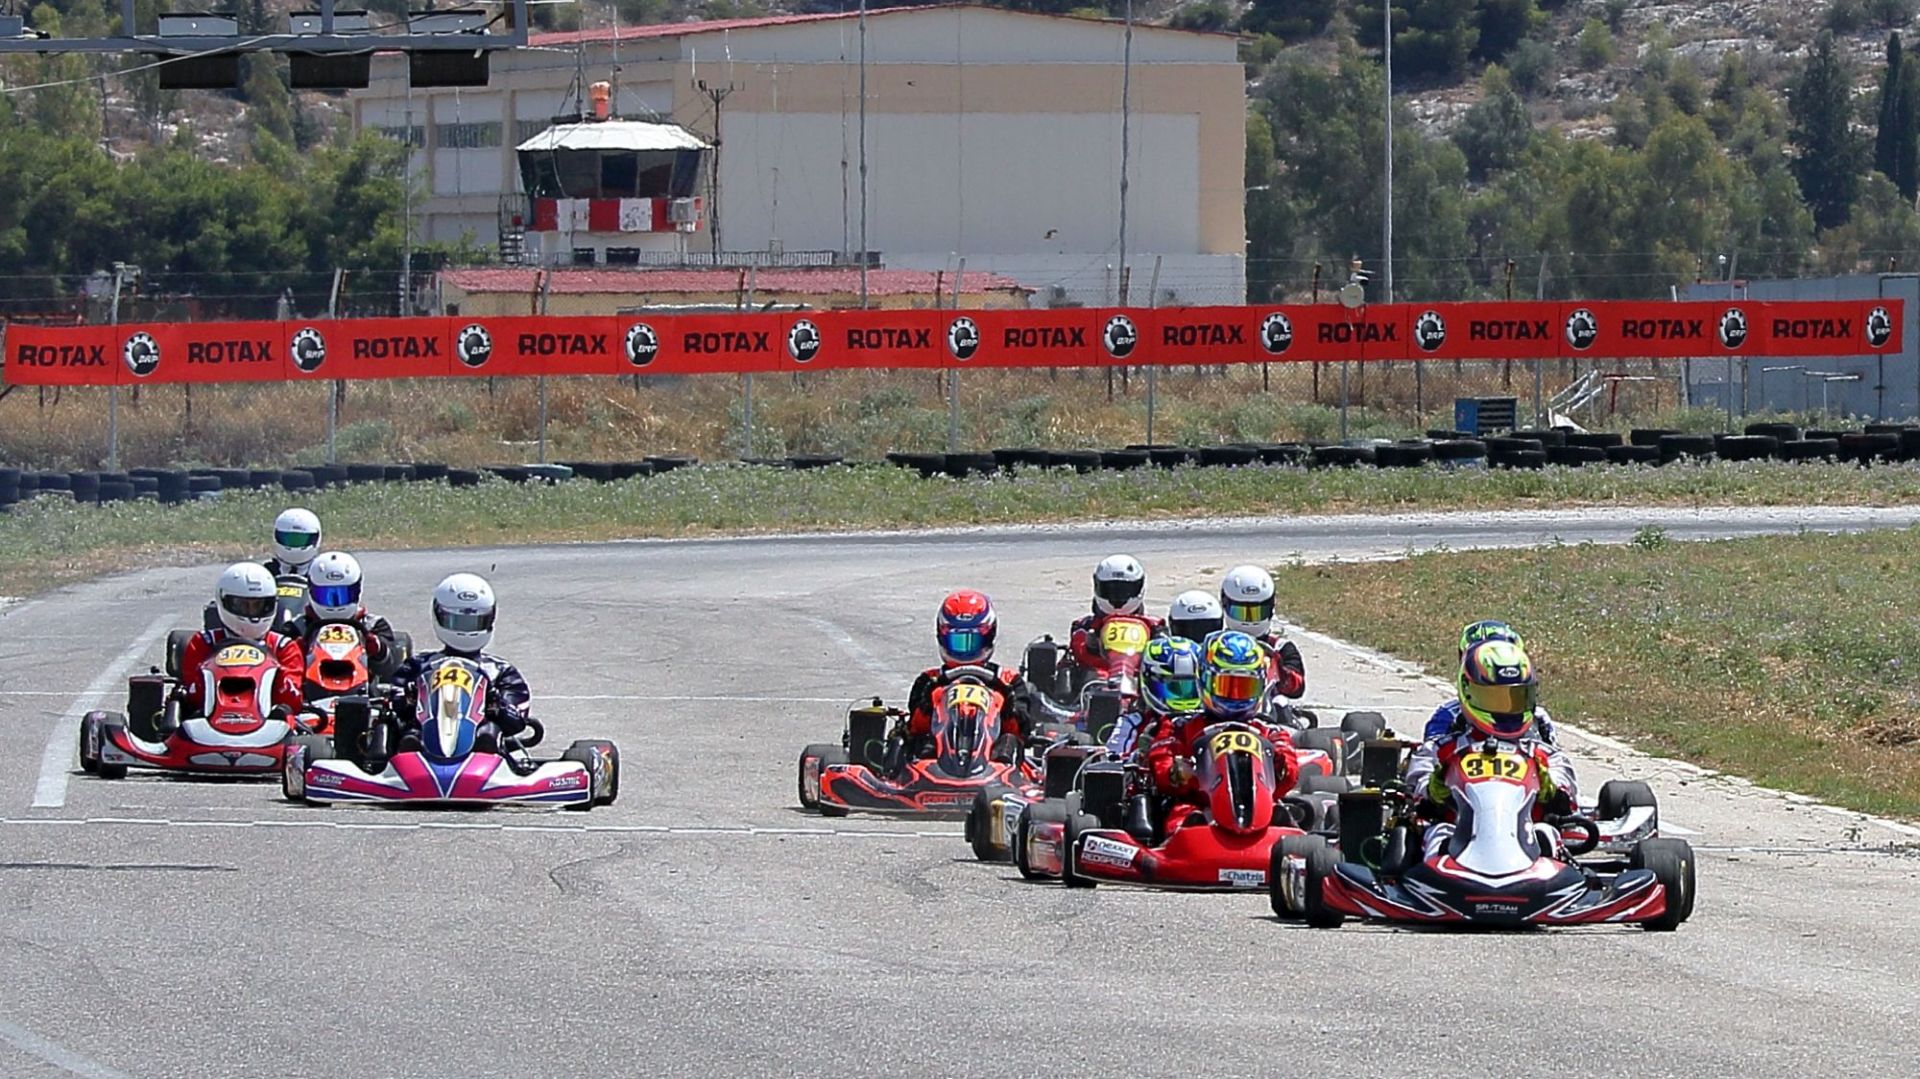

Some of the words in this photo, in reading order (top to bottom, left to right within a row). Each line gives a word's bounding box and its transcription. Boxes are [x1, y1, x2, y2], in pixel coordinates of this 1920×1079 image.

[848, 329, 929, 349] ROTAX
[1005, 328, 1084, 347] ROTAX
[1163, 324, 1243, 346] ROTAX
[1318, 320, 1396, 343] ROTAX
[1470, 320, 1549, 340] ROTAX
[1622, 319, 1703, 339] ROTAX
[1773, 319, 1851, 339] ROTAX
[189, 341, 271, 363] ROTAX
[354, 337, 437, 358] ROTAX
[518, 334, 605, 355] ROTAX
[684, 332, 768, 353] ROTAX
[18, 345, 104, 366] ROTAX
[1108, 626, 1141, 641] 370
[219, 648, 260, 661] 379
[431, 669, 472, 689] 347
[1466, 758, 1520, 777] 312
